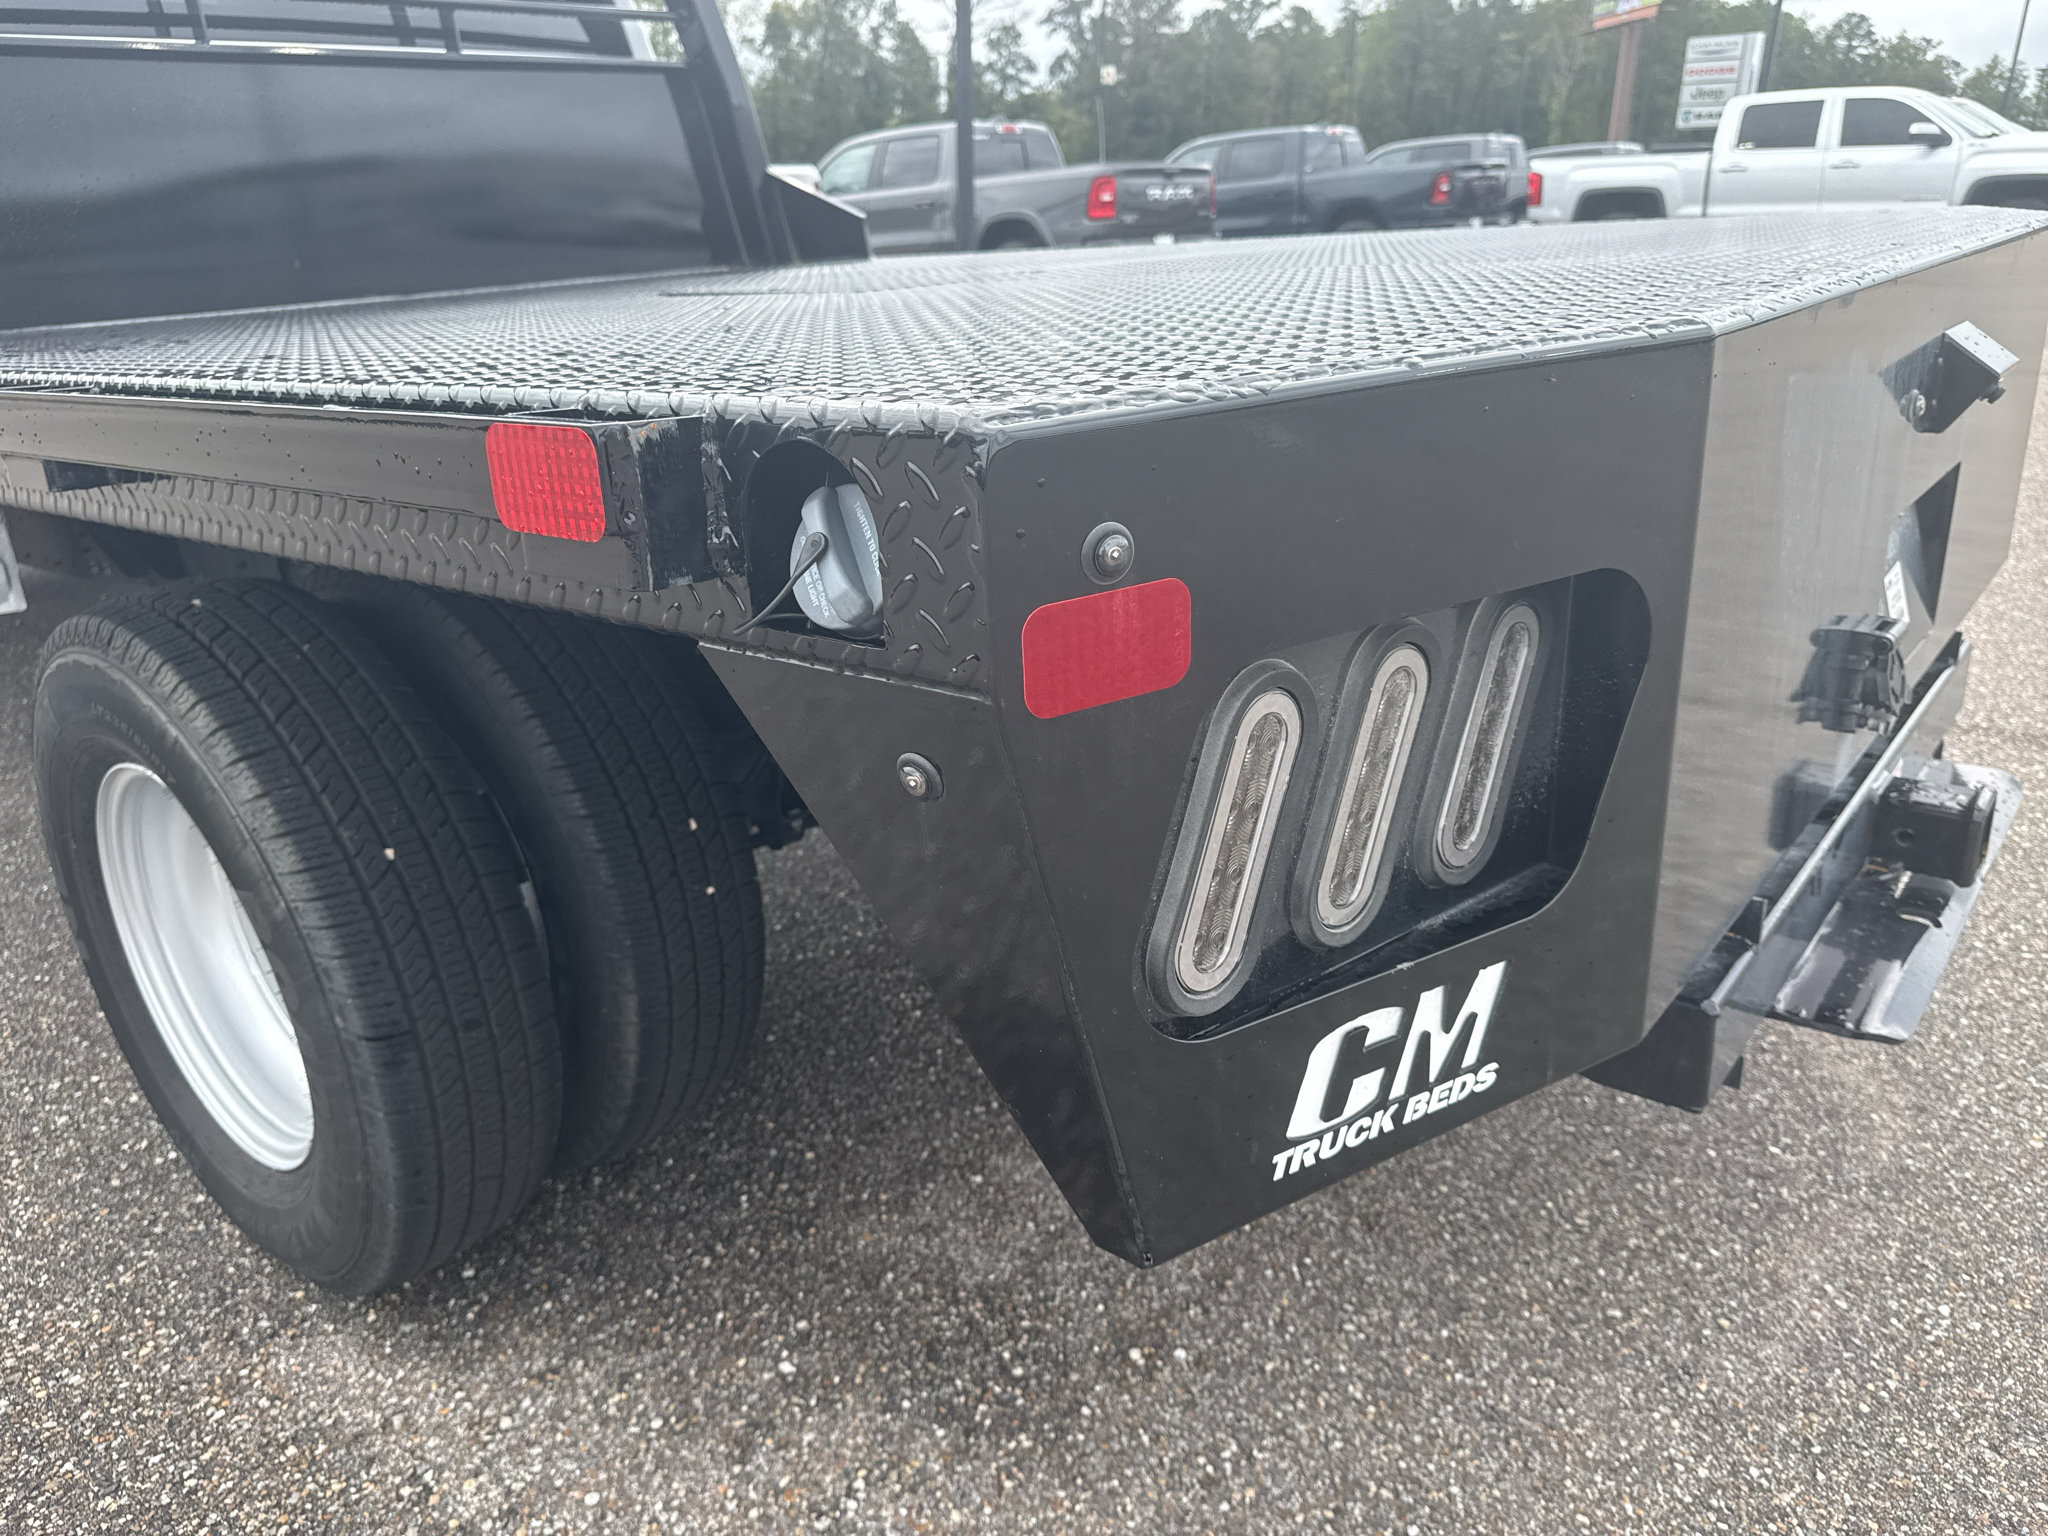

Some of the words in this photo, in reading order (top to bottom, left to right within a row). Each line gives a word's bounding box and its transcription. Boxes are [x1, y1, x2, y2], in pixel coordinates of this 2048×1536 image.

[1146, 184, 1194, 200] RAM
[853, 502, 872, 540] TIGHTEN
[867, 537, 876, 552] TO
[807, 585, 819, 607] LIGHT
[819, 592, 830, 618] CHECK
[1286, 960, 1507, 1140] CM
[1272, 1103, 1399, 1182] TRUCK
[1402, 1062, 1500, 1125] BEDS
